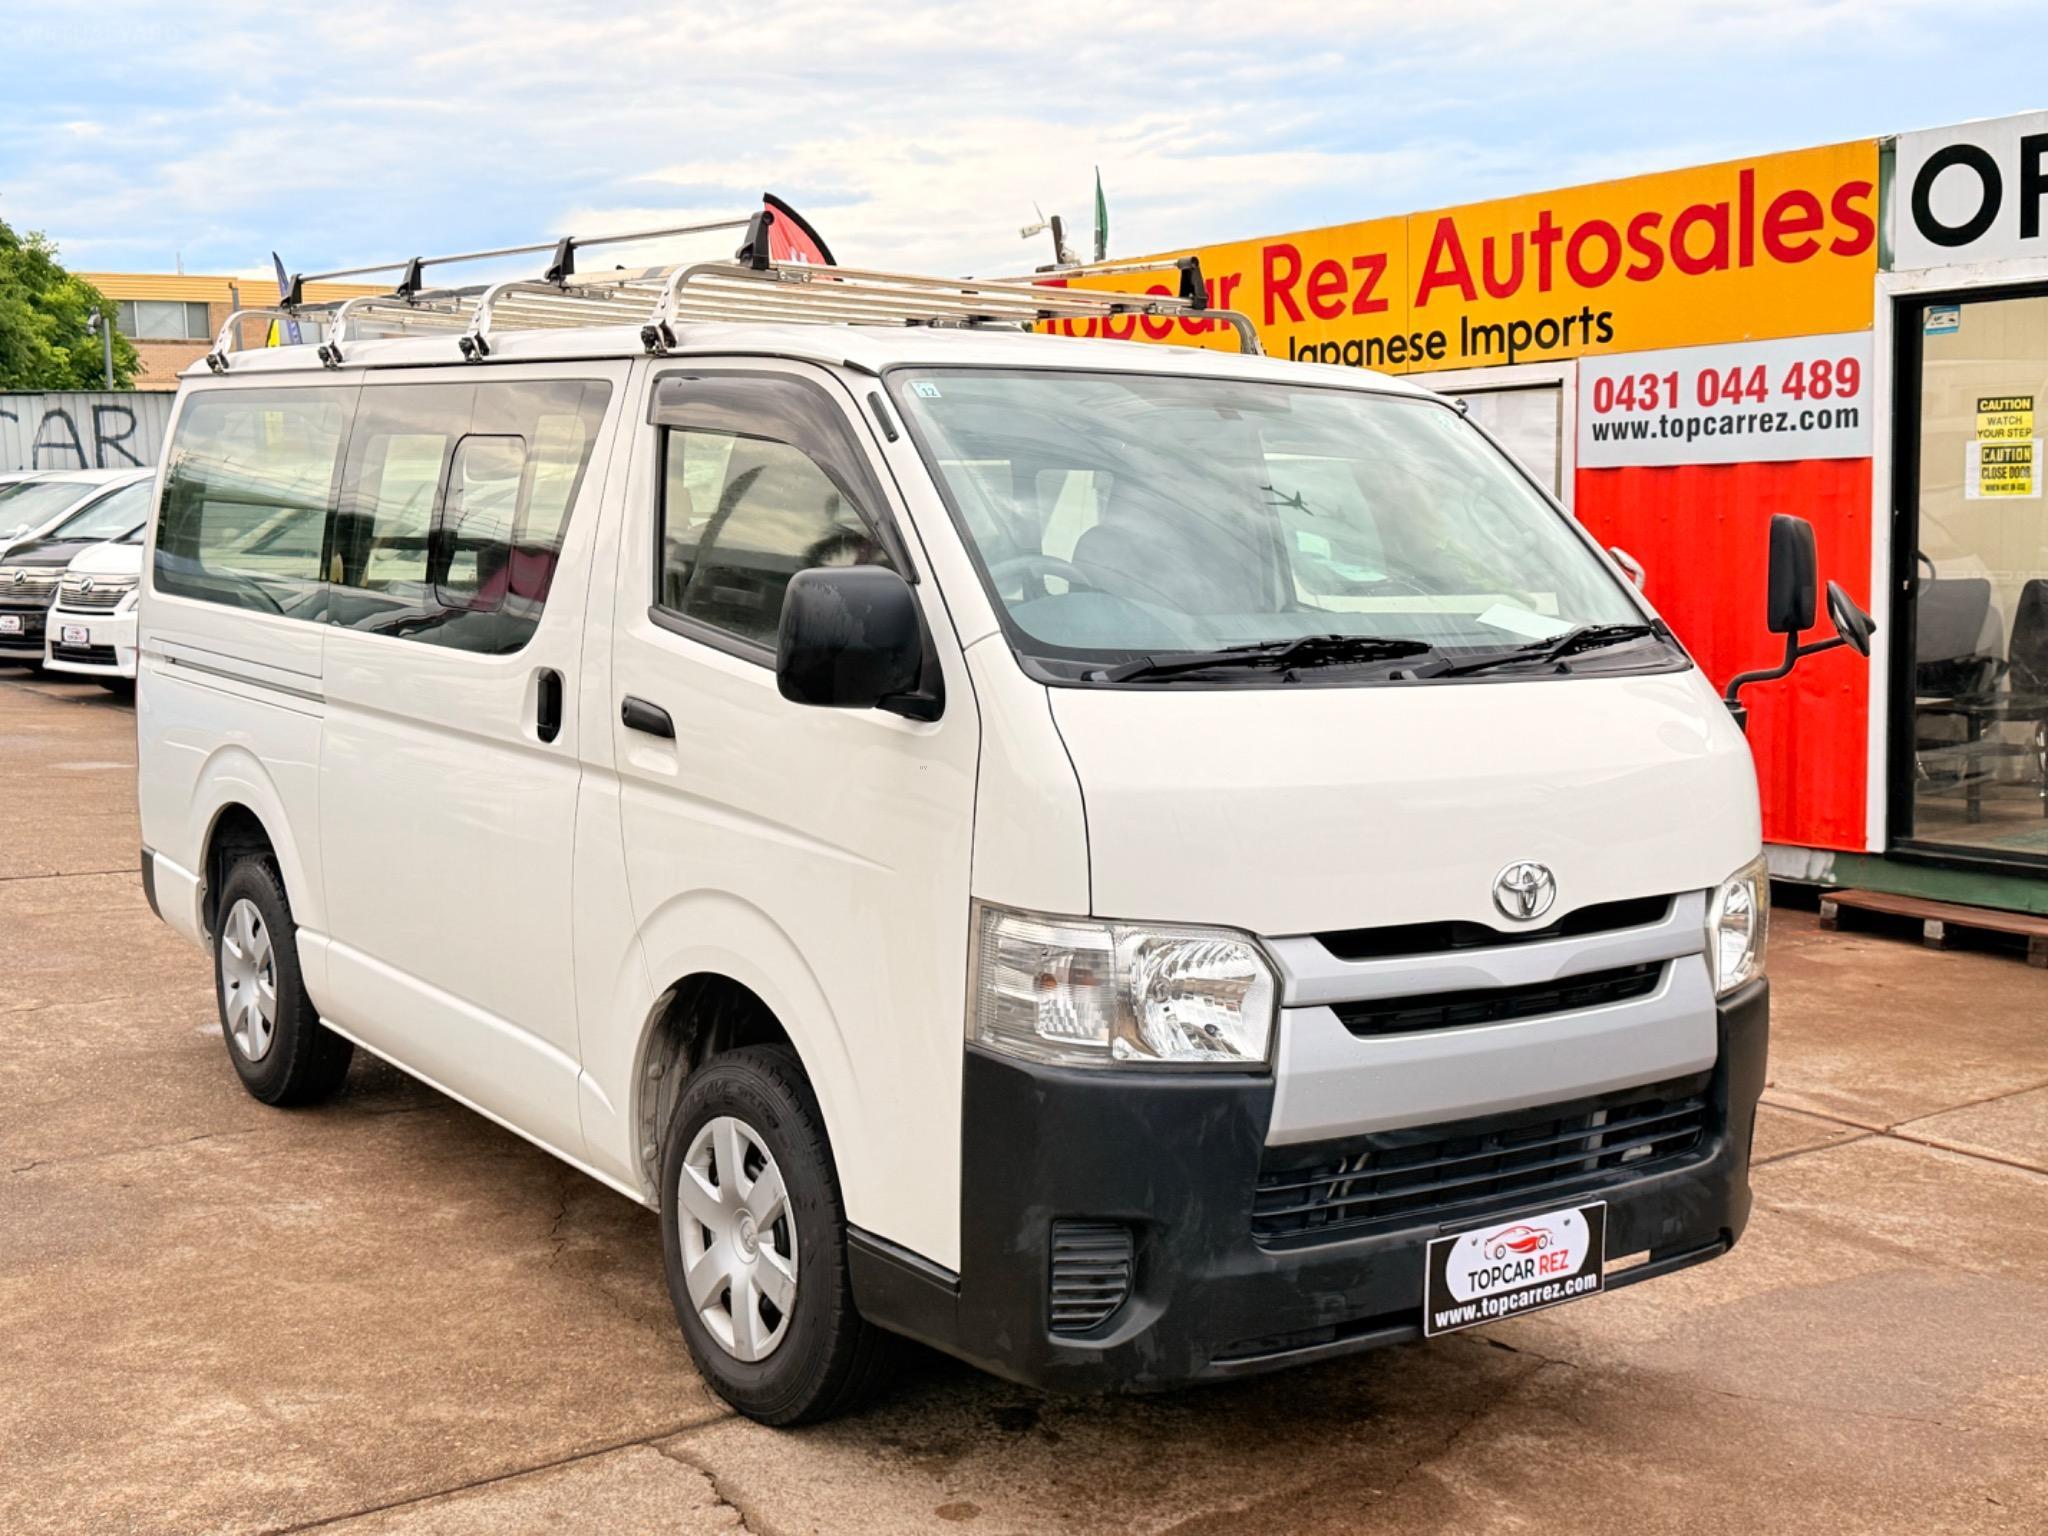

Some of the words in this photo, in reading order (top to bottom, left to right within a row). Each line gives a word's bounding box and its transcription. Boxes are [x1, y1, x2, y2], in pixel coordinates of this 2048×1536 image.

[1263, 243, 1388, 326] Rez
[1414, 168, 1875, 307] Autosales
[1461, 306, 1613, 366] Imports
[1593, 371, 1679, 414] 0431
[1697, 364, 1769, 407] 044
[1782, 357, 1861, 400] 489
[1980, 398, 2030, 411] CAUTION
[0, 404, 145, 470] AR
[1592, 407, 1859, 442] www.topcarrez.com
[1977, 428, 2005, 438] YOUR
[2007, 428, 2032, 438] STEP
[1987, 416, 2023, 426] WATCH
[1982, 466, 2008, 480] CLOSE
[1983, 447, 2032, 463] CAUTION
[1468, 1258, 1534, 1293] TOPCAR
[1539, 1249, 1569, 1275] REZ
[1435, 1273, 1597, 1327] www.topcarrez.com
